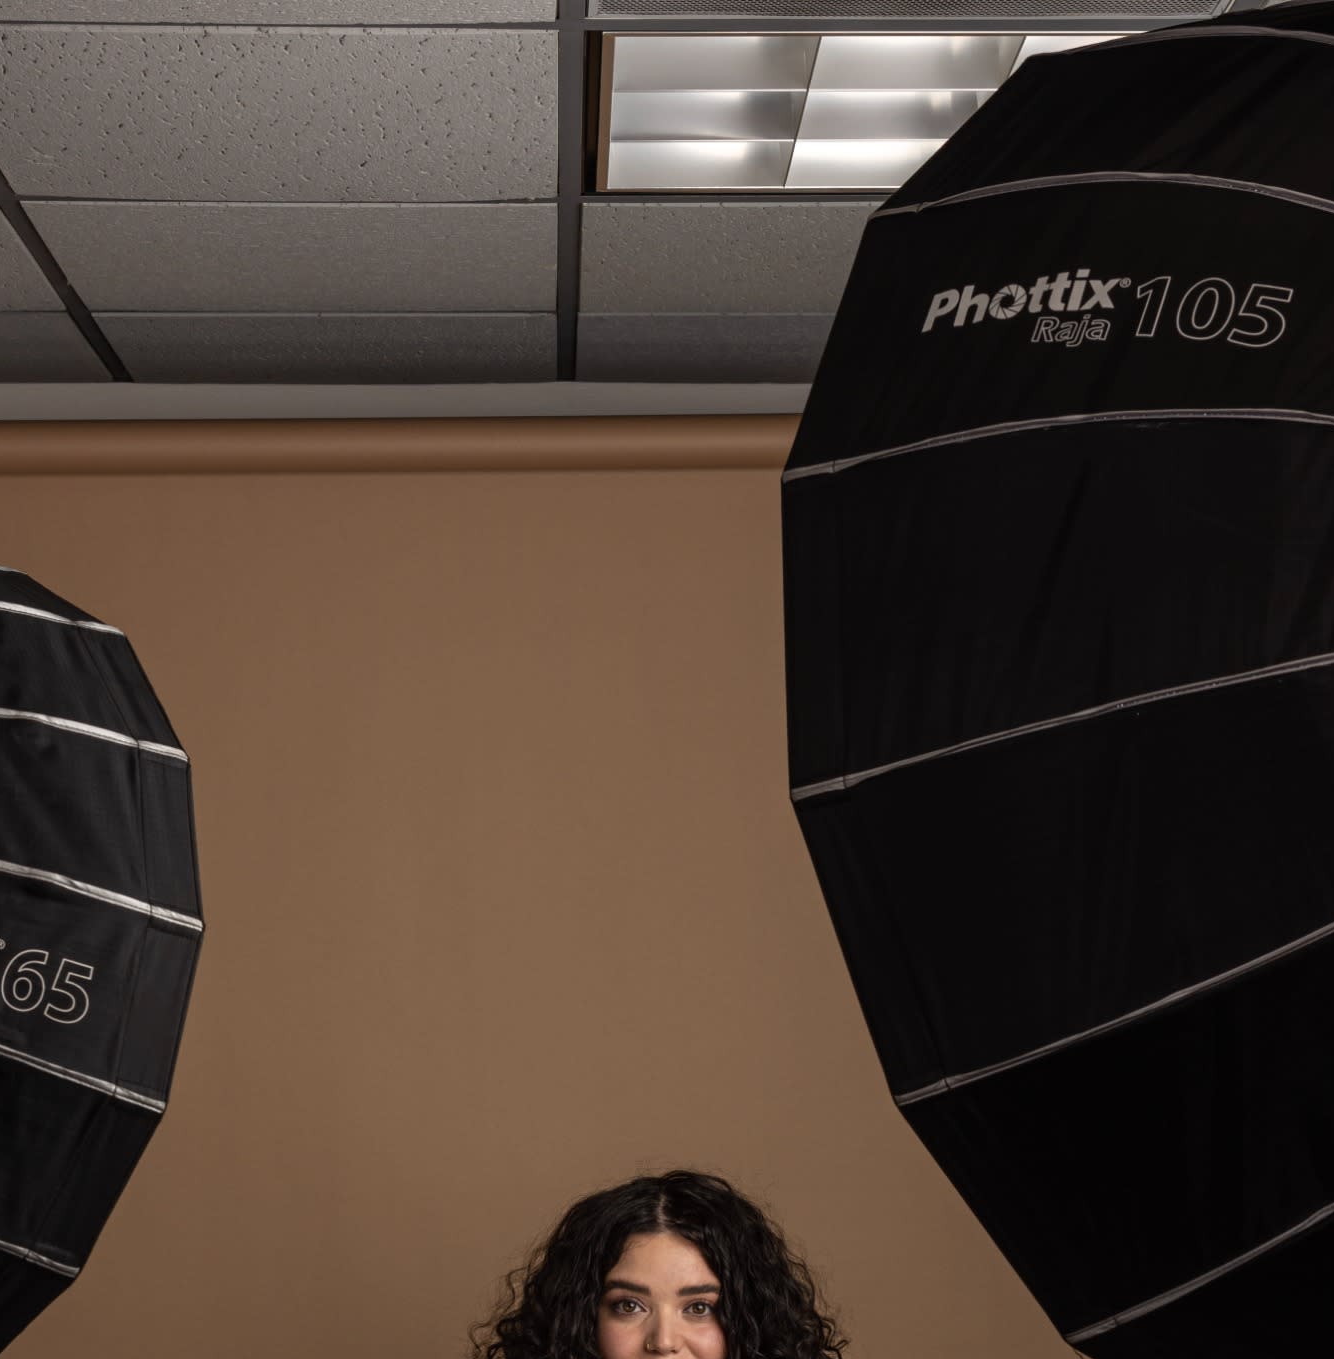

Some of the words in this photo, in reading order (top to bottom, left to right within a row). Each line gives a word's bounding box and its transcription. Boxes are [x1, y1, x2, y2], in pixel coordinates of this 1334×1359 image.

[1030, 313, 1111, 348] Raja
[1135, 275, 1294, 348] 105
[0, 948, 95, 1025] 65
